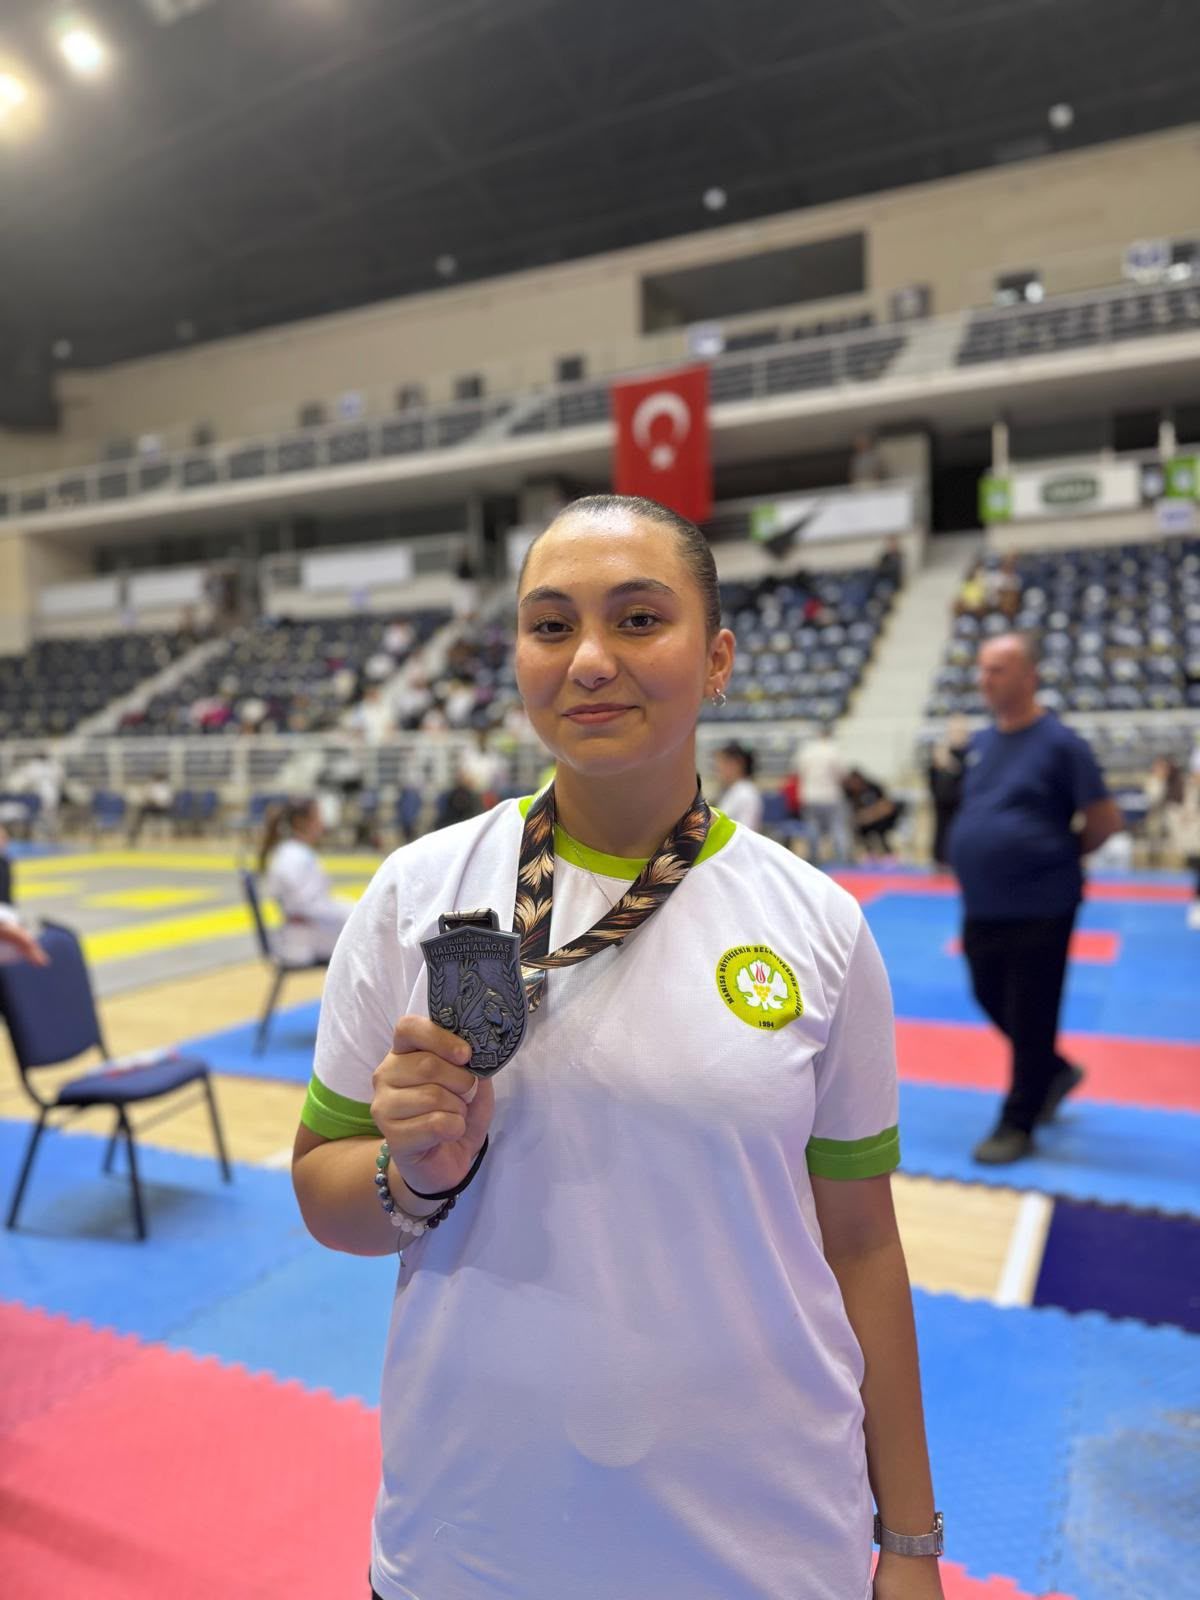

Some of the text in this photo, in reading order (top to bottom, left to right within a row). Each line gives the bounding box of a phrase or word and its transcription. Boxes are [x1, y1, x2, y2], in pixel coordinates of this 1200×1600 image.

[432, 944, 470, 956] HALDUN
[434, 952, 508, 962] KARATE TURNUVASI
